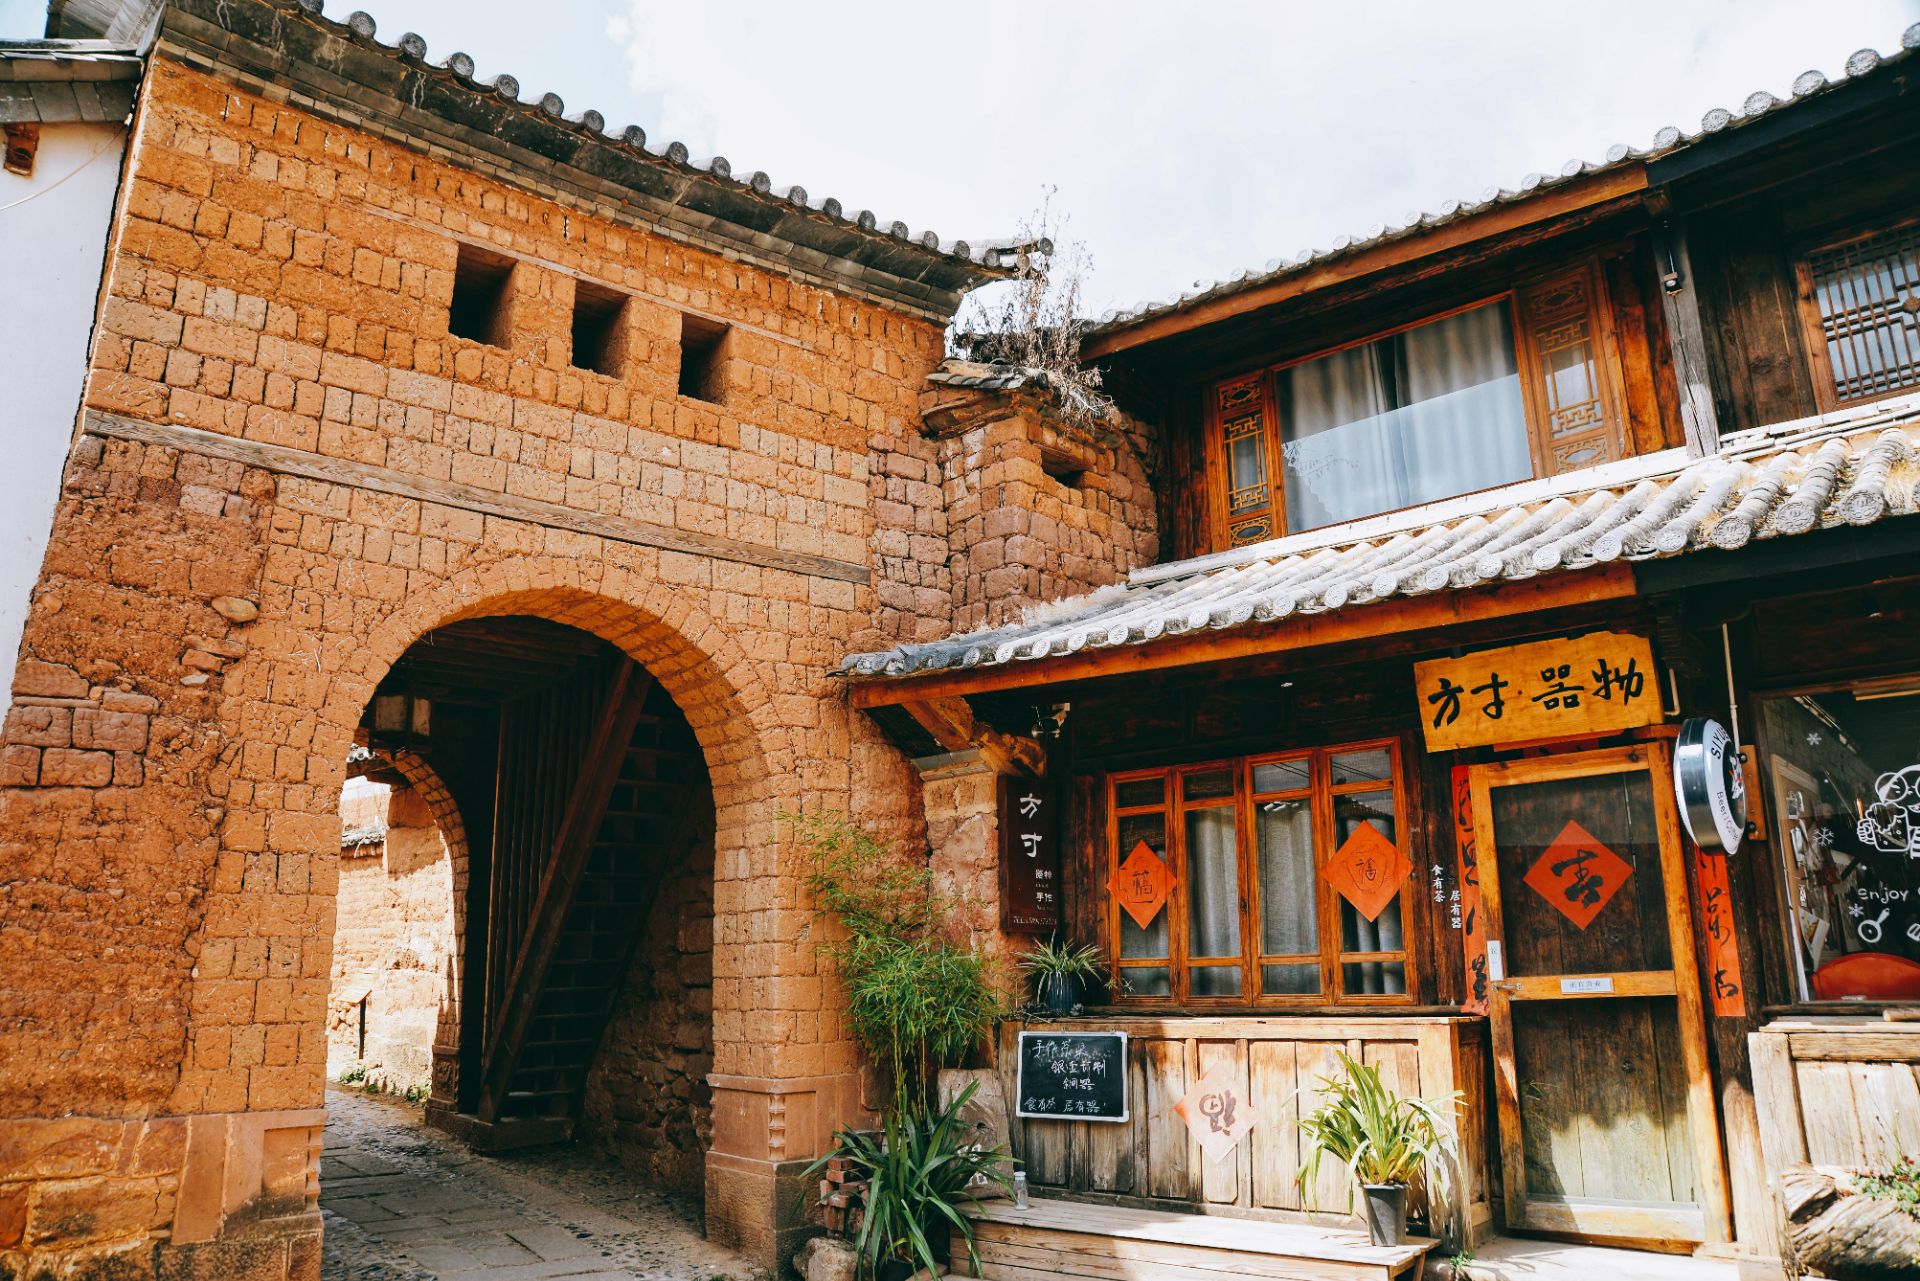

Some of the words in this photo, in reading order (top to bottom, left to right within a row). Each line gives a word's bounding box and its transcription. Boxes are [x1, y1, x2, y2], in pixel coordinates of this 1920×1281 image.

[1019, 792, 1043, 858] 方寸
[1431, 864, 1446, 903] 食有茶
[1449, 890, 1462, 929] 居有器
